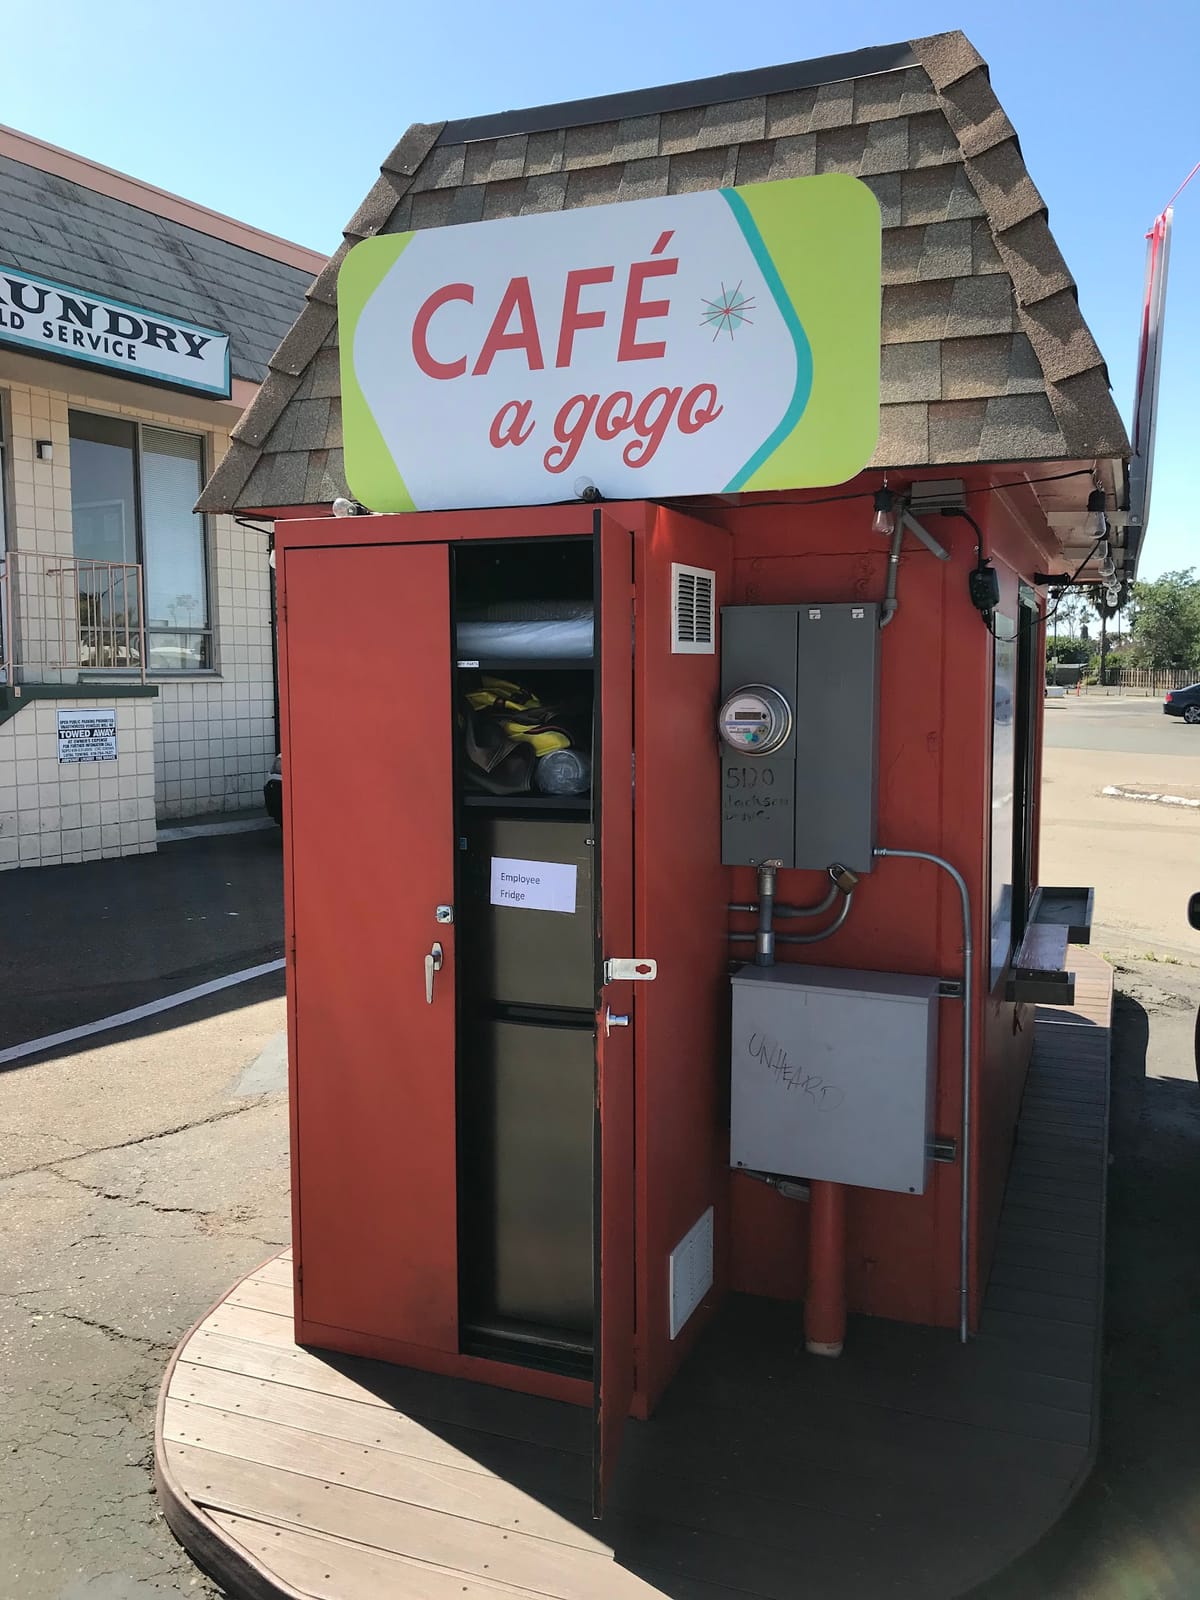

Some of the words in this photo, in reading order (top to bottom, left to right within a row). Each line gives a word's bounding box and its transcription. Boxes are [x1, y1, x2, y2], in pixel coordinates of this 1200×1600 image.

[411, 230, 679, 380] CAFÉ
[43, 321, 137, 361] SERVICE
[489, 399, 536, 449] a
[543, 383, 724, 474] gogo
[60, 730, 90, 738] TOWED
[93, 728, 114, 737] AWAY
[500, 872, 541, 885] Employee
[500, 889, 526, 902] Fridge
